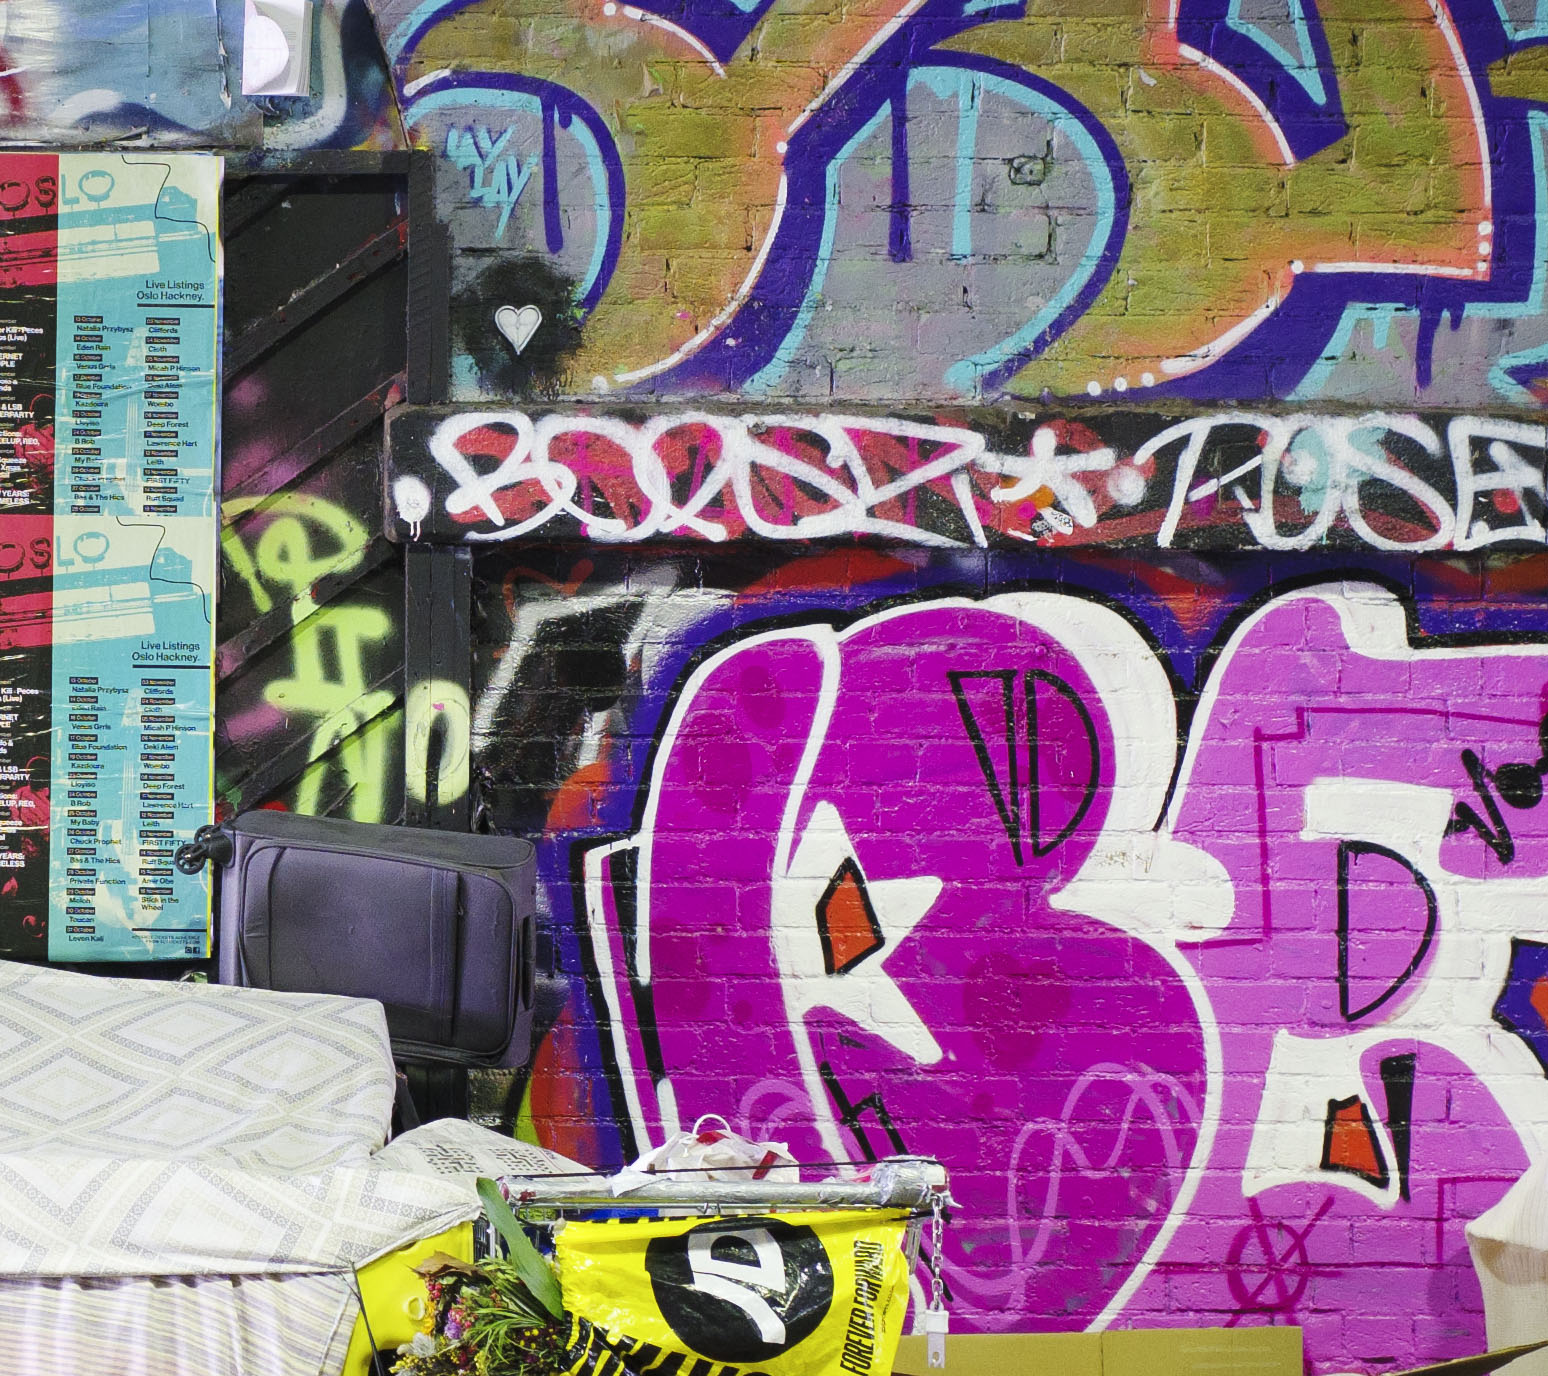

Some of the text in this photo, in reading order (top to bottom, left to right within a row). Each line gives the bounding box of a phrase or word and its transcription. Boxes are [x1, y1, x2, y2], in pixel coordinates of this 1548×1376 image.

[145, 280, 205, 291] Live Listings
[137, 291, 205, 302] Oslo Hackney.
[850, 1239, 884, 1310] FORWARD
